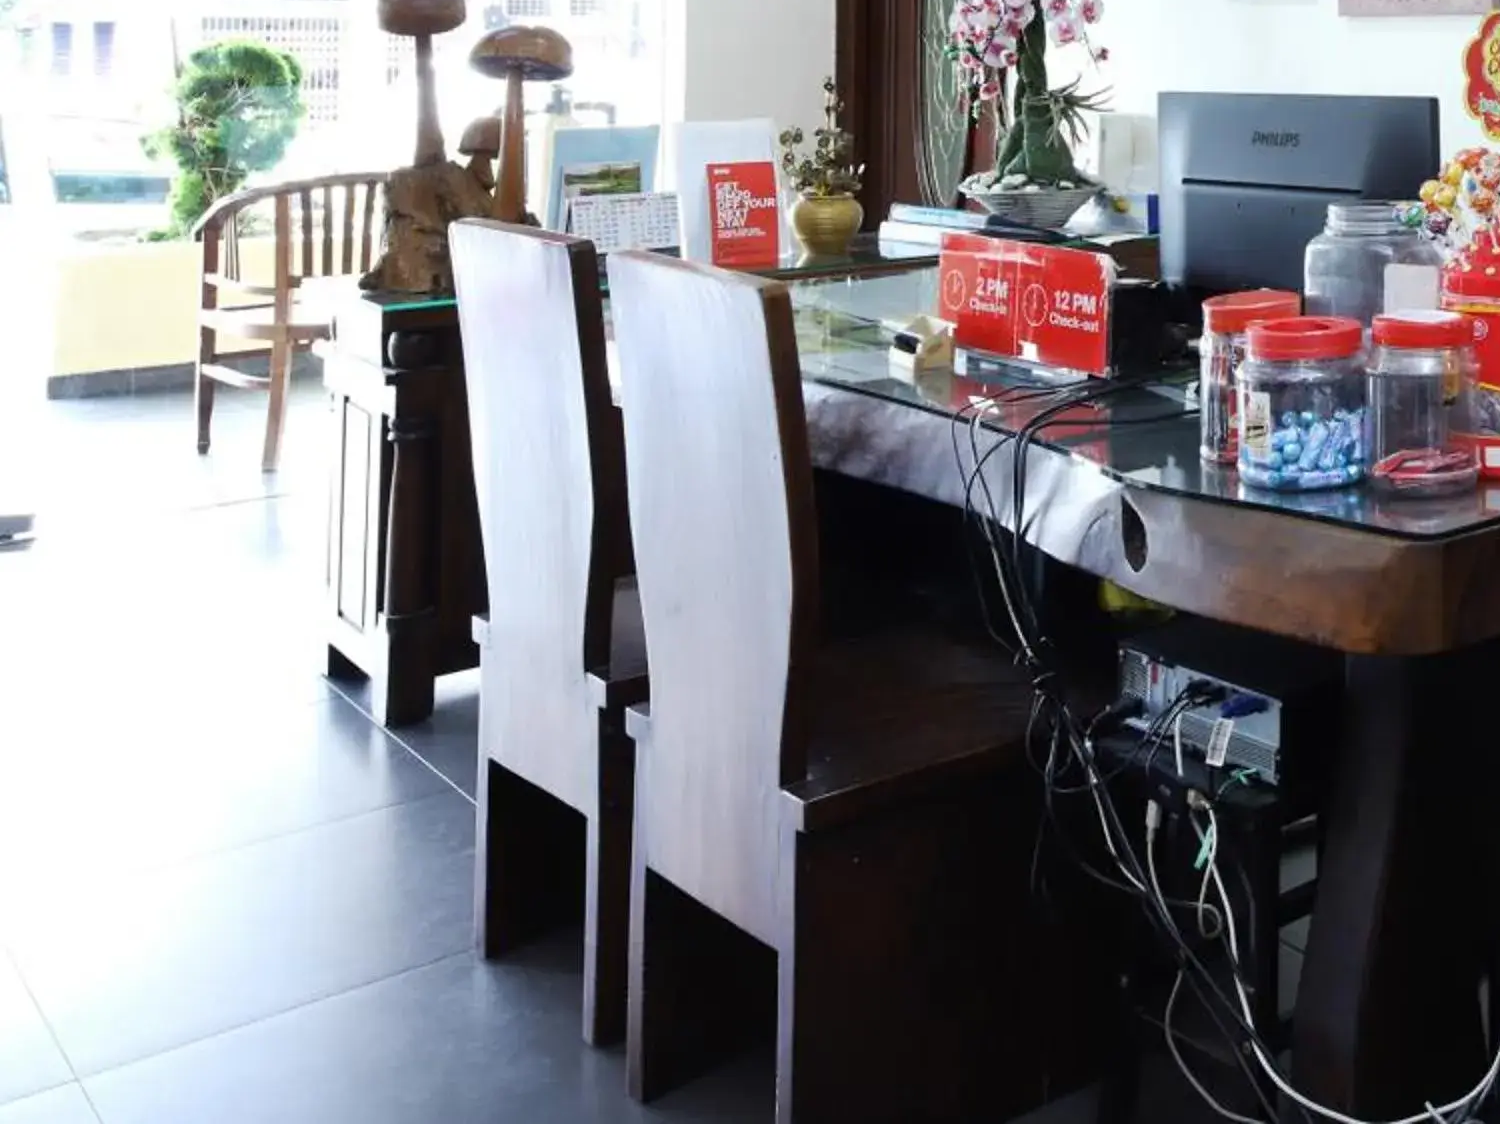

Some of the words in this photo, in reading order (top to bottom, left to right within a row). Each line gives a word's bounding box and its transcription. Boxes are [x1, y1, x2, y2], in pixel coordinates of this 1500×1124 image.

[1251, 131, 1300, 147] PHILIPS
[744, 197, 775, 208] YOUR
[976, 277, 985, 295] 2
[987, 278, 1008, 299] PM
[1054, 290, 1070, 310] 12
[1072, 292, 1096, 314] PM
[1050, 312, 1099, 333] Check-out
